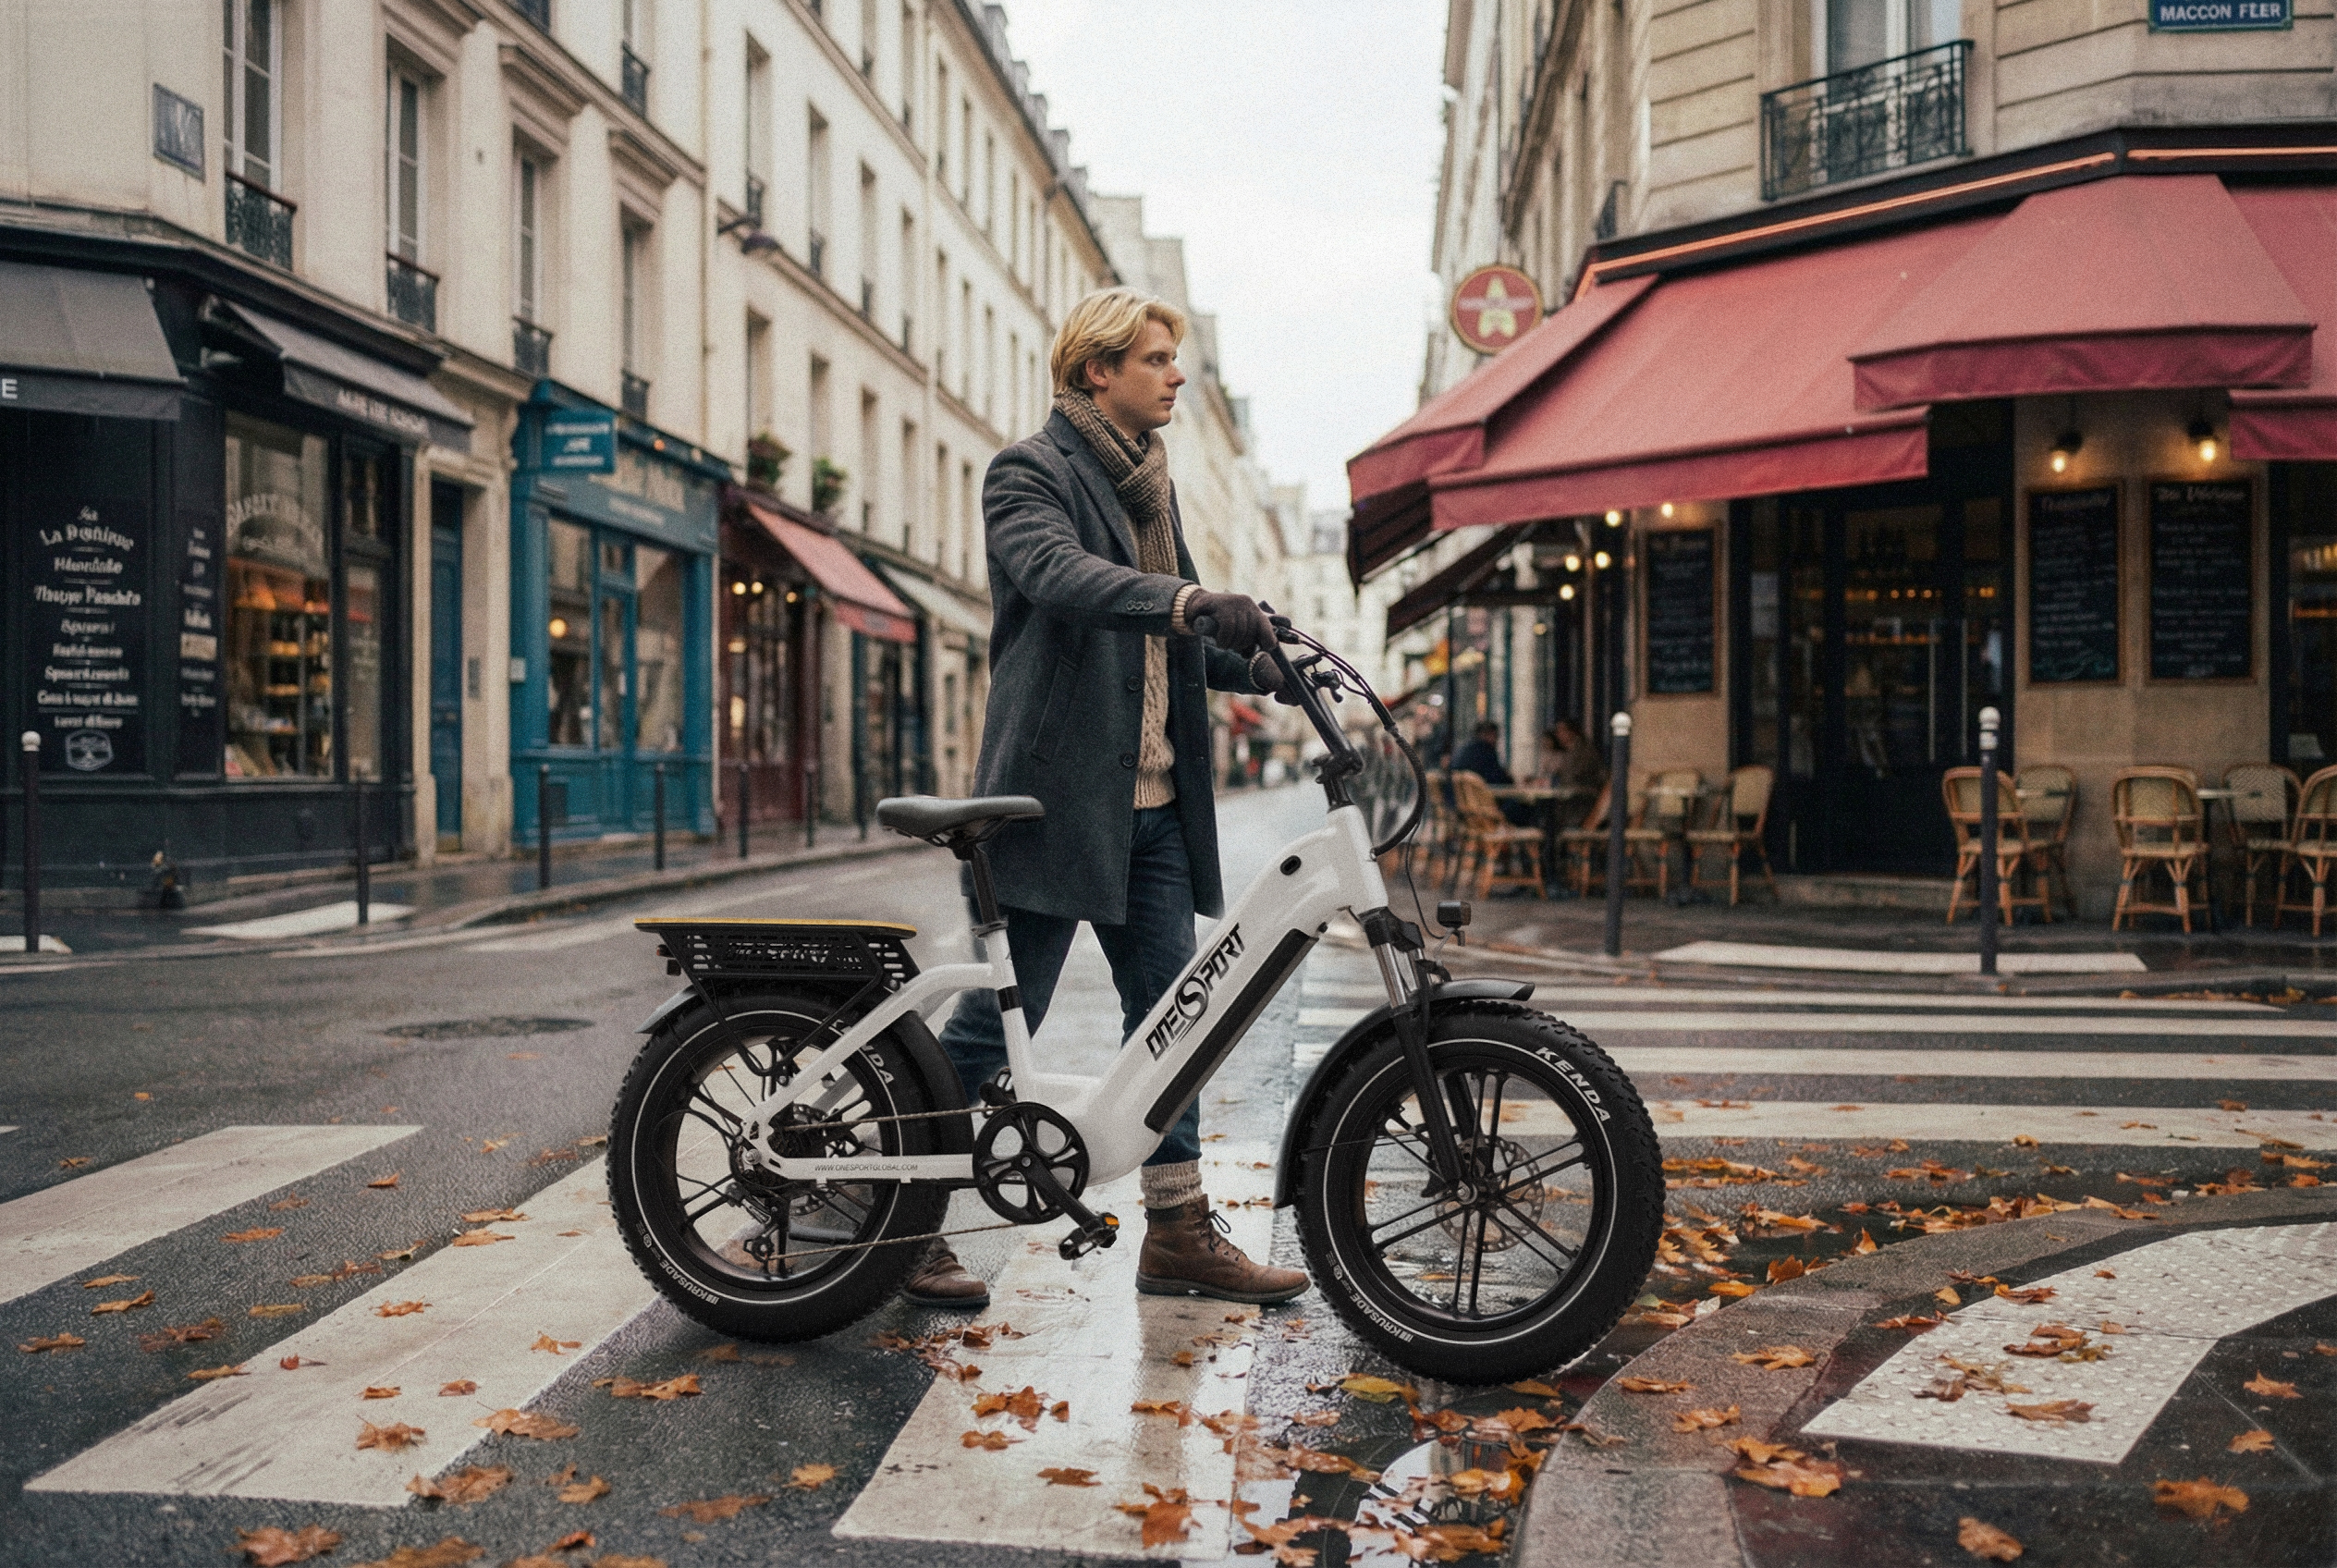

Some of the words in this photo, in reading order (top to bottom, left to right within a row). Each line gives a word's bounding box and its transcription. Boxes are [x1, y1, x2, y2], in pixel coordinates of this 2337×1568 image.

[2160, 4, 2233, 22] MACCON
[2, 378, 18, 399] E
[1535, 1046, 1611, 1122] KENDA
[659, 1258, 709, 1300] KRUSADE
[1349, 1292, 1402, 1337] KRUSADE
